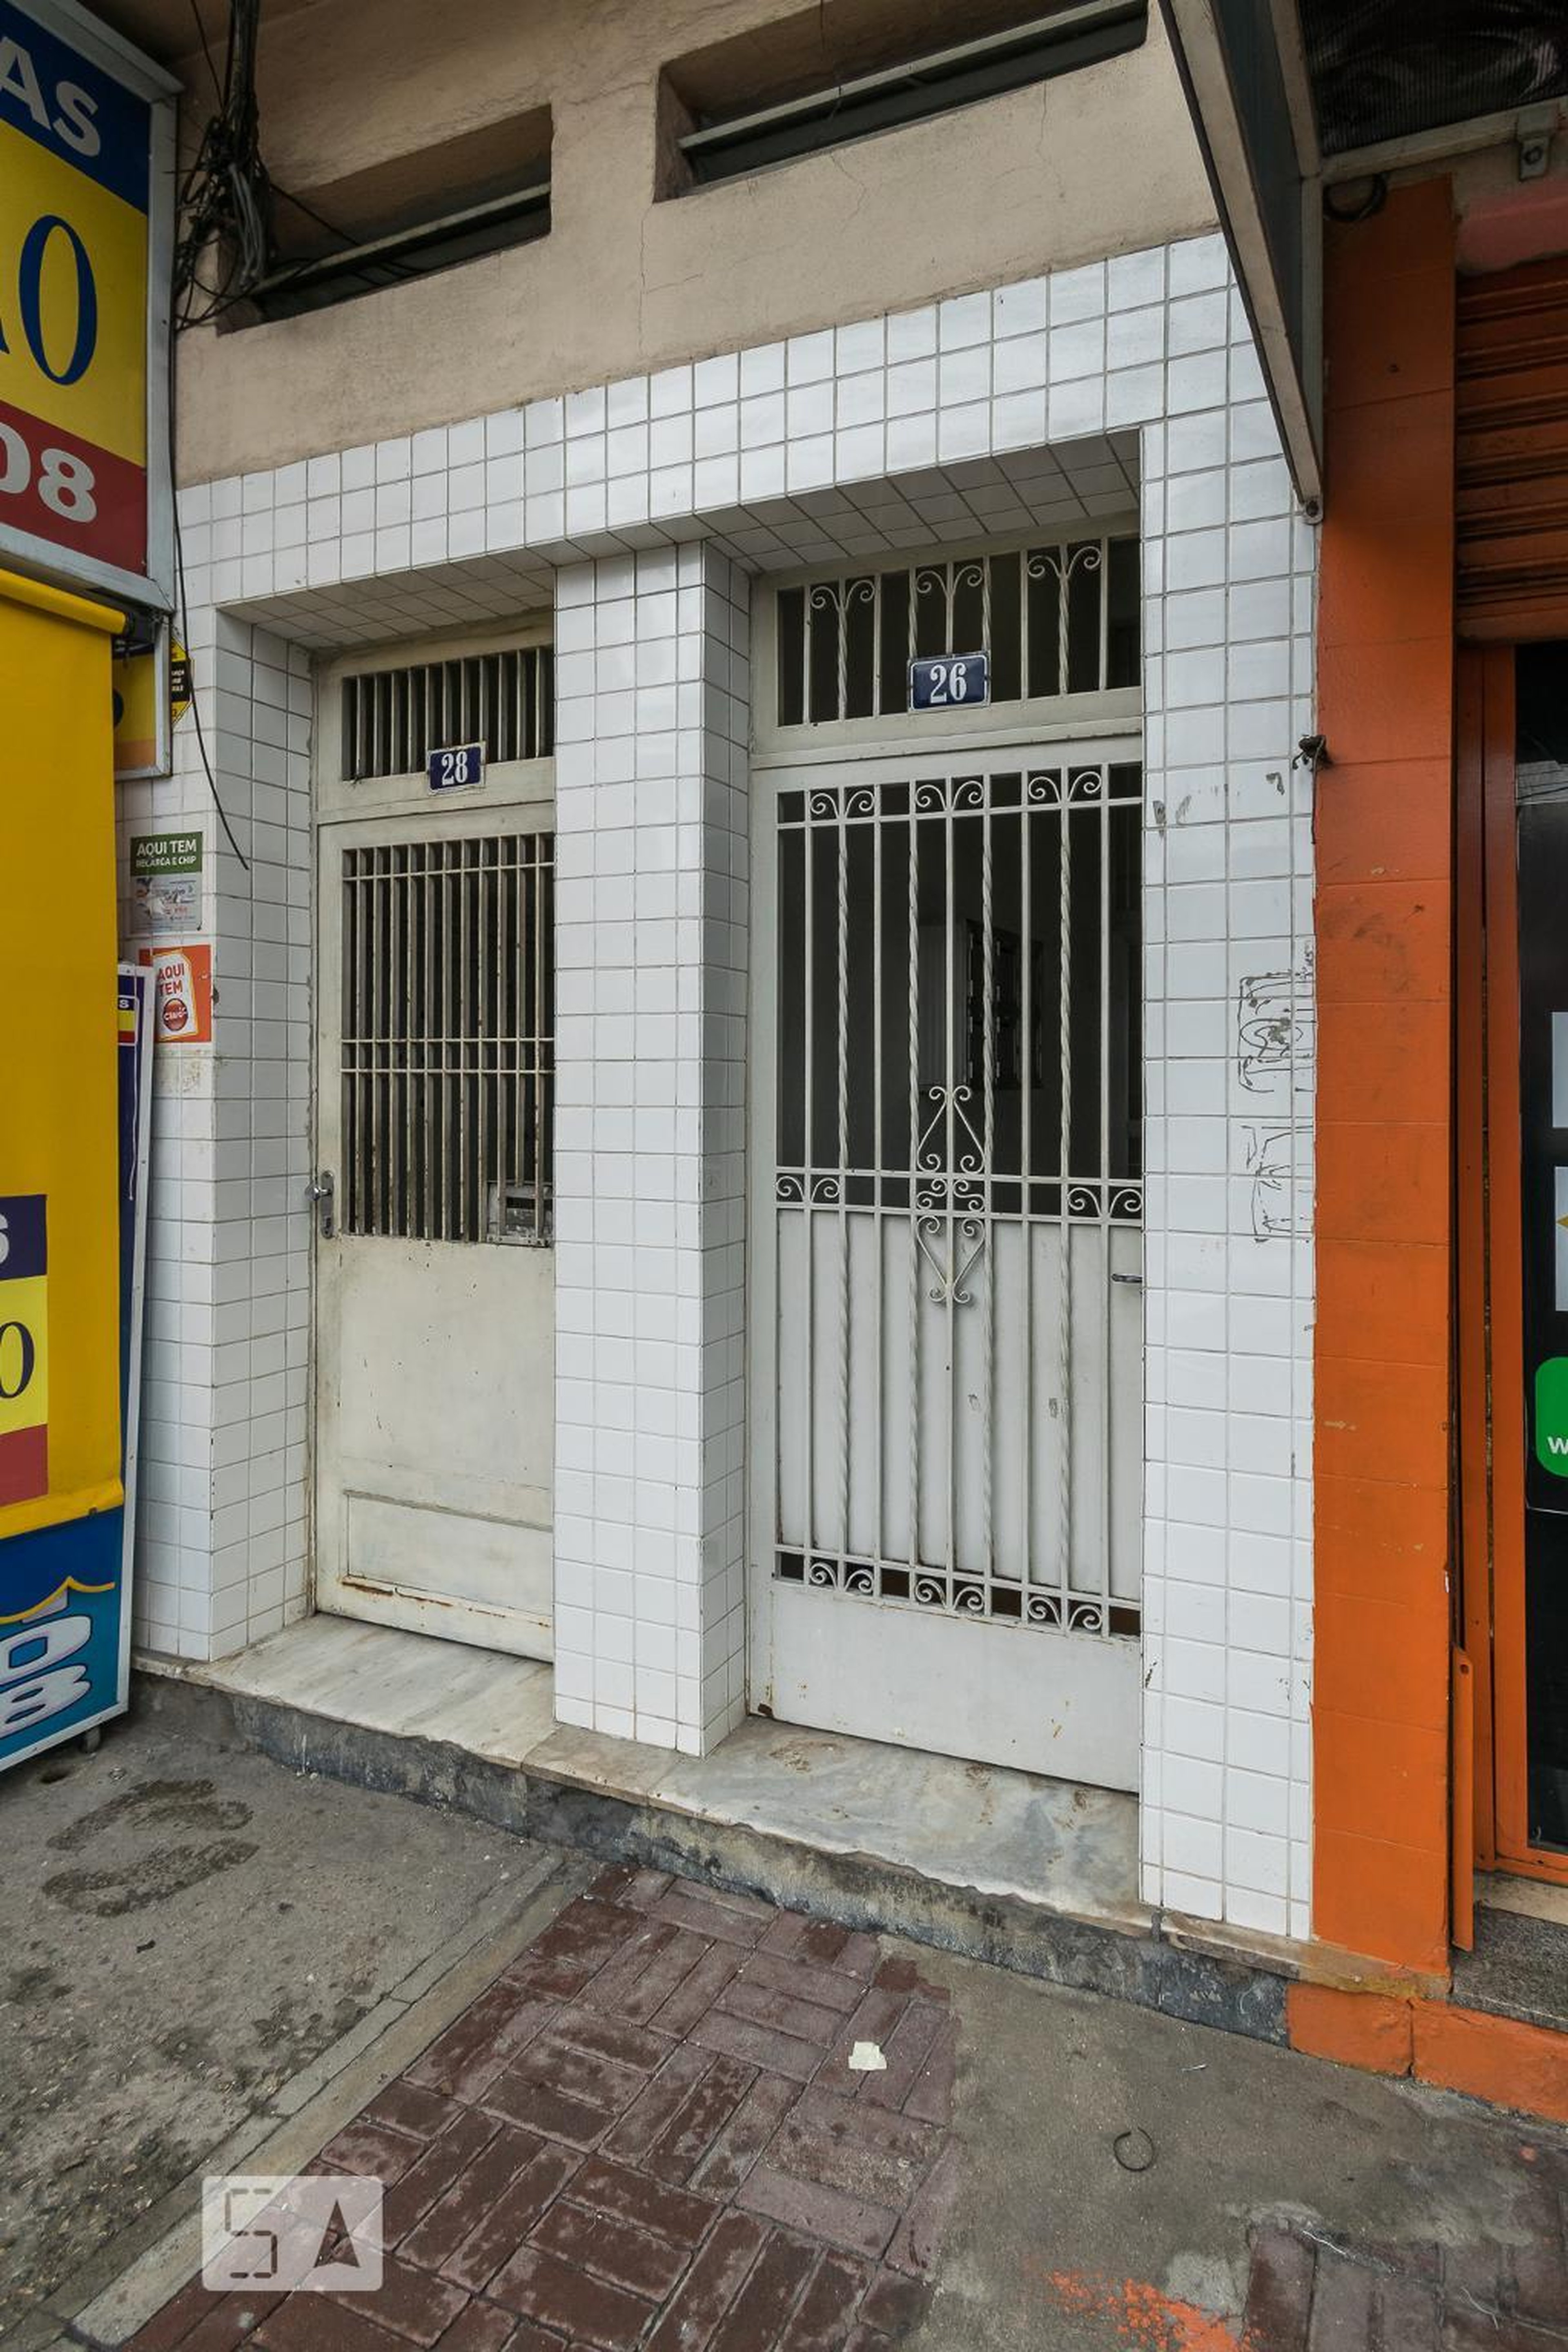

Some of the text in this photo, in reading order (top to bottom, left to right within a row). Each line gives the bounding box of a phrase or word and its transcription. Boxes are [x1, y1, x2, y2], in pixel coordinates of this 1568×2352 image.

[930, 662, 967, 703] 26
[442, 751, 468, 785] 28
[136, 839, 197, 857] AQUI TEM
[172, 857, 177, 865] E
[178, 855, 197, 864] CHIP
[157, 963, 185, 981] AQUI
[158, 980, 183, 996] TEM
